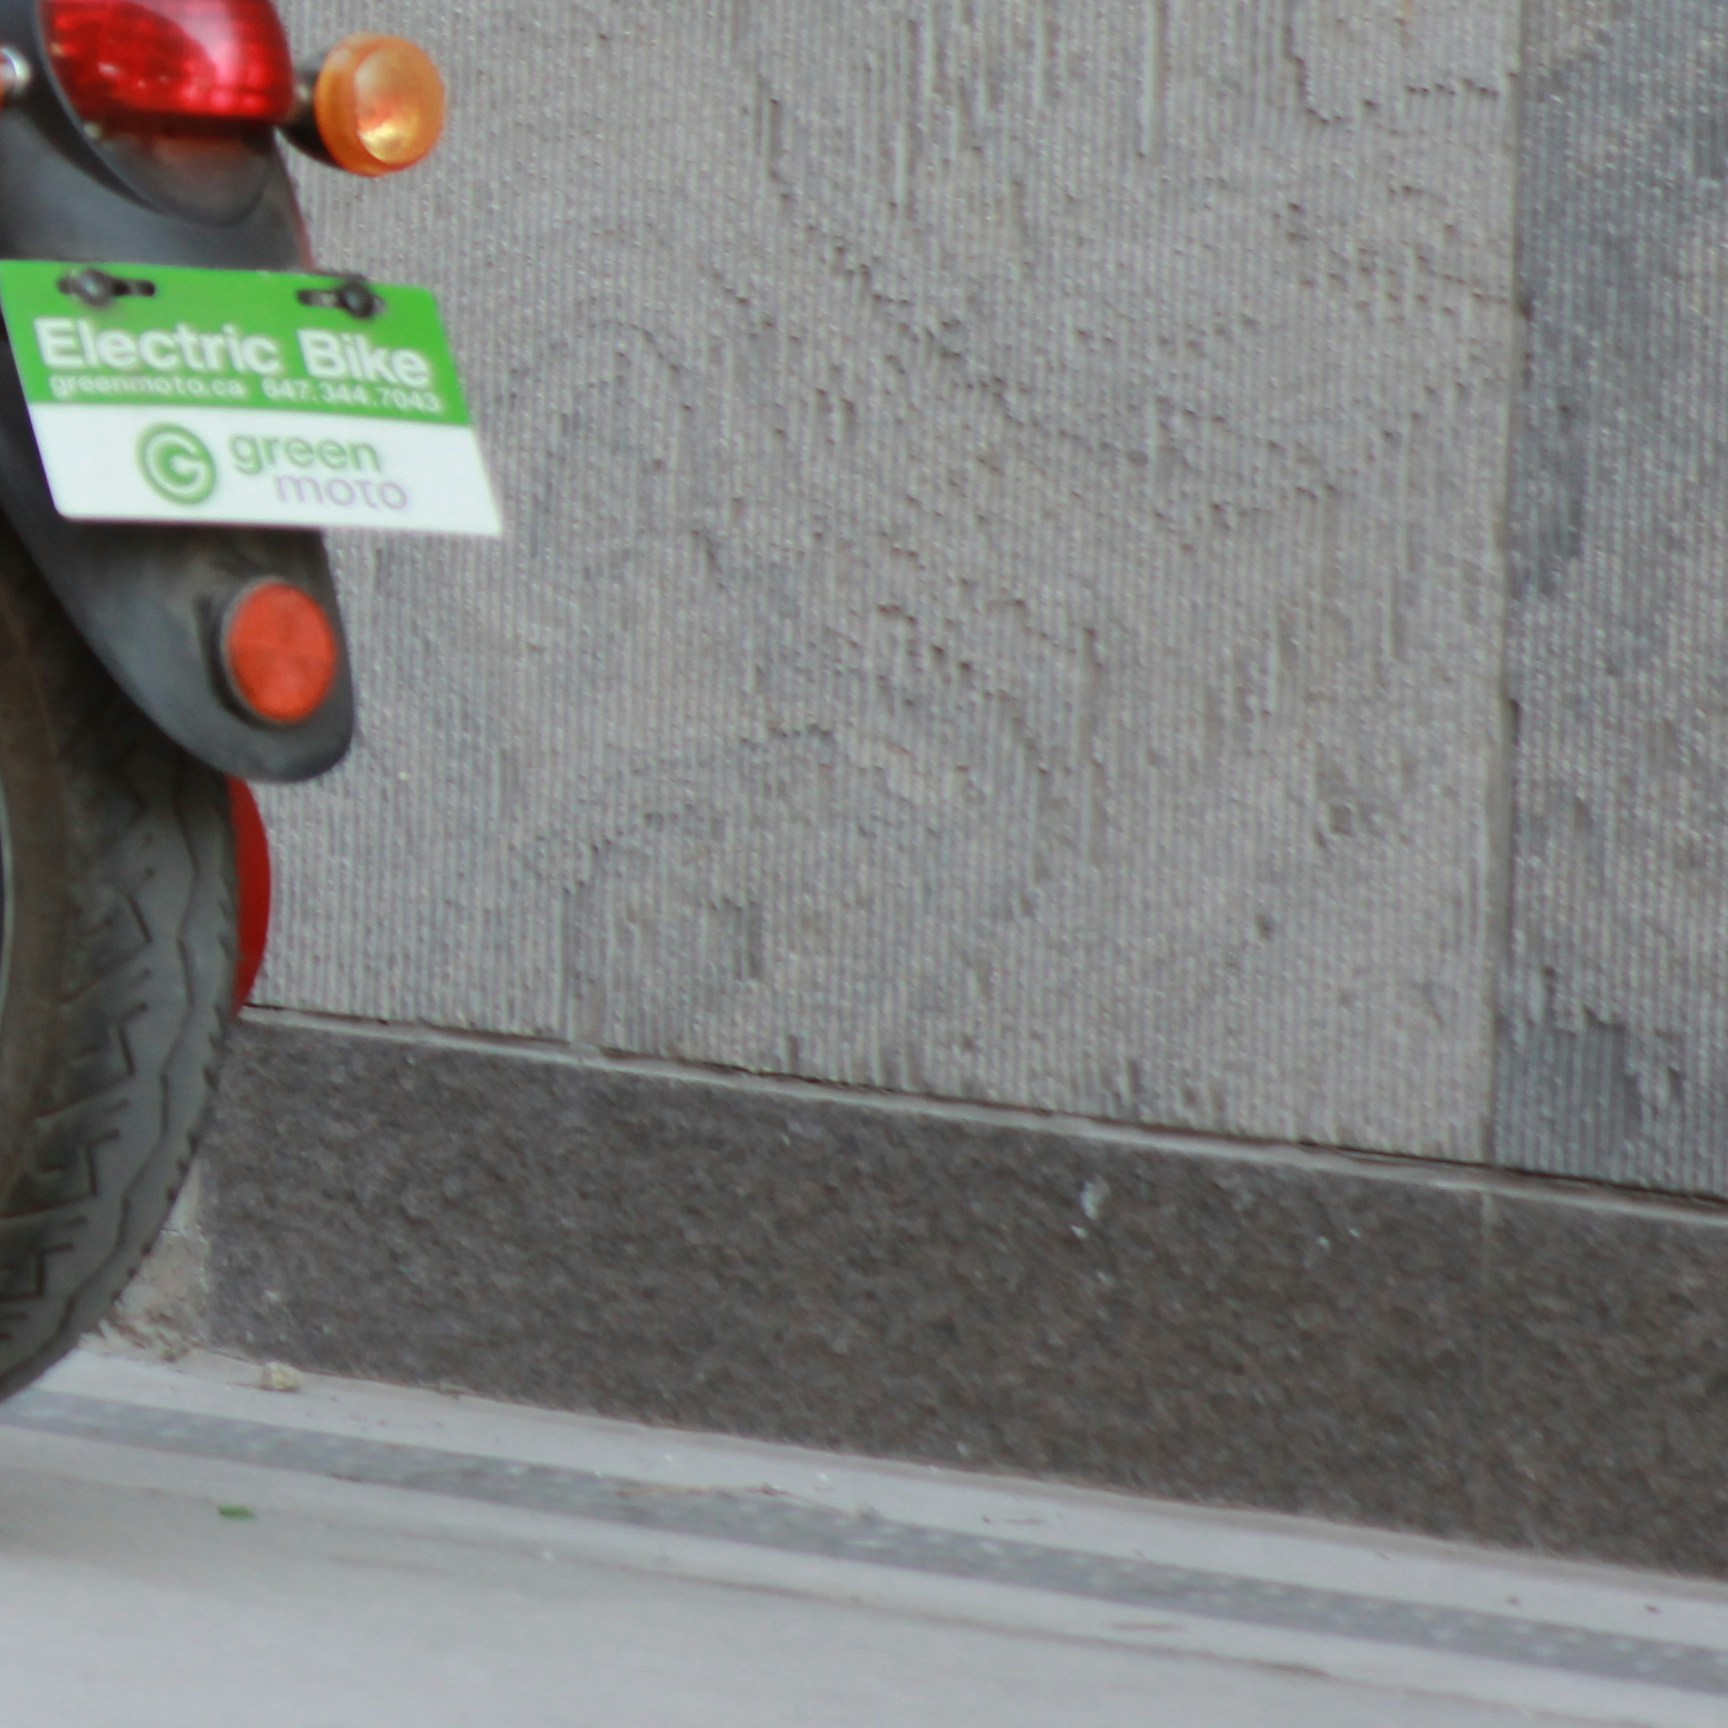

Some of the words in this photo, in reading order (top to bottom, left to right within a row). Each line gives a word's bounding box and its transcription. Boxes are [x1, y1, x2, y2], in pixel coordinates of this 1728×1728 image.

[33, 316, 283, 374] Electric
[297, 328, 431, 388] Bike
[48, 374, 245, 399] greenmoto.ca
[228, 432, 380, 475] green
[275, 475, 408, 510] moto
